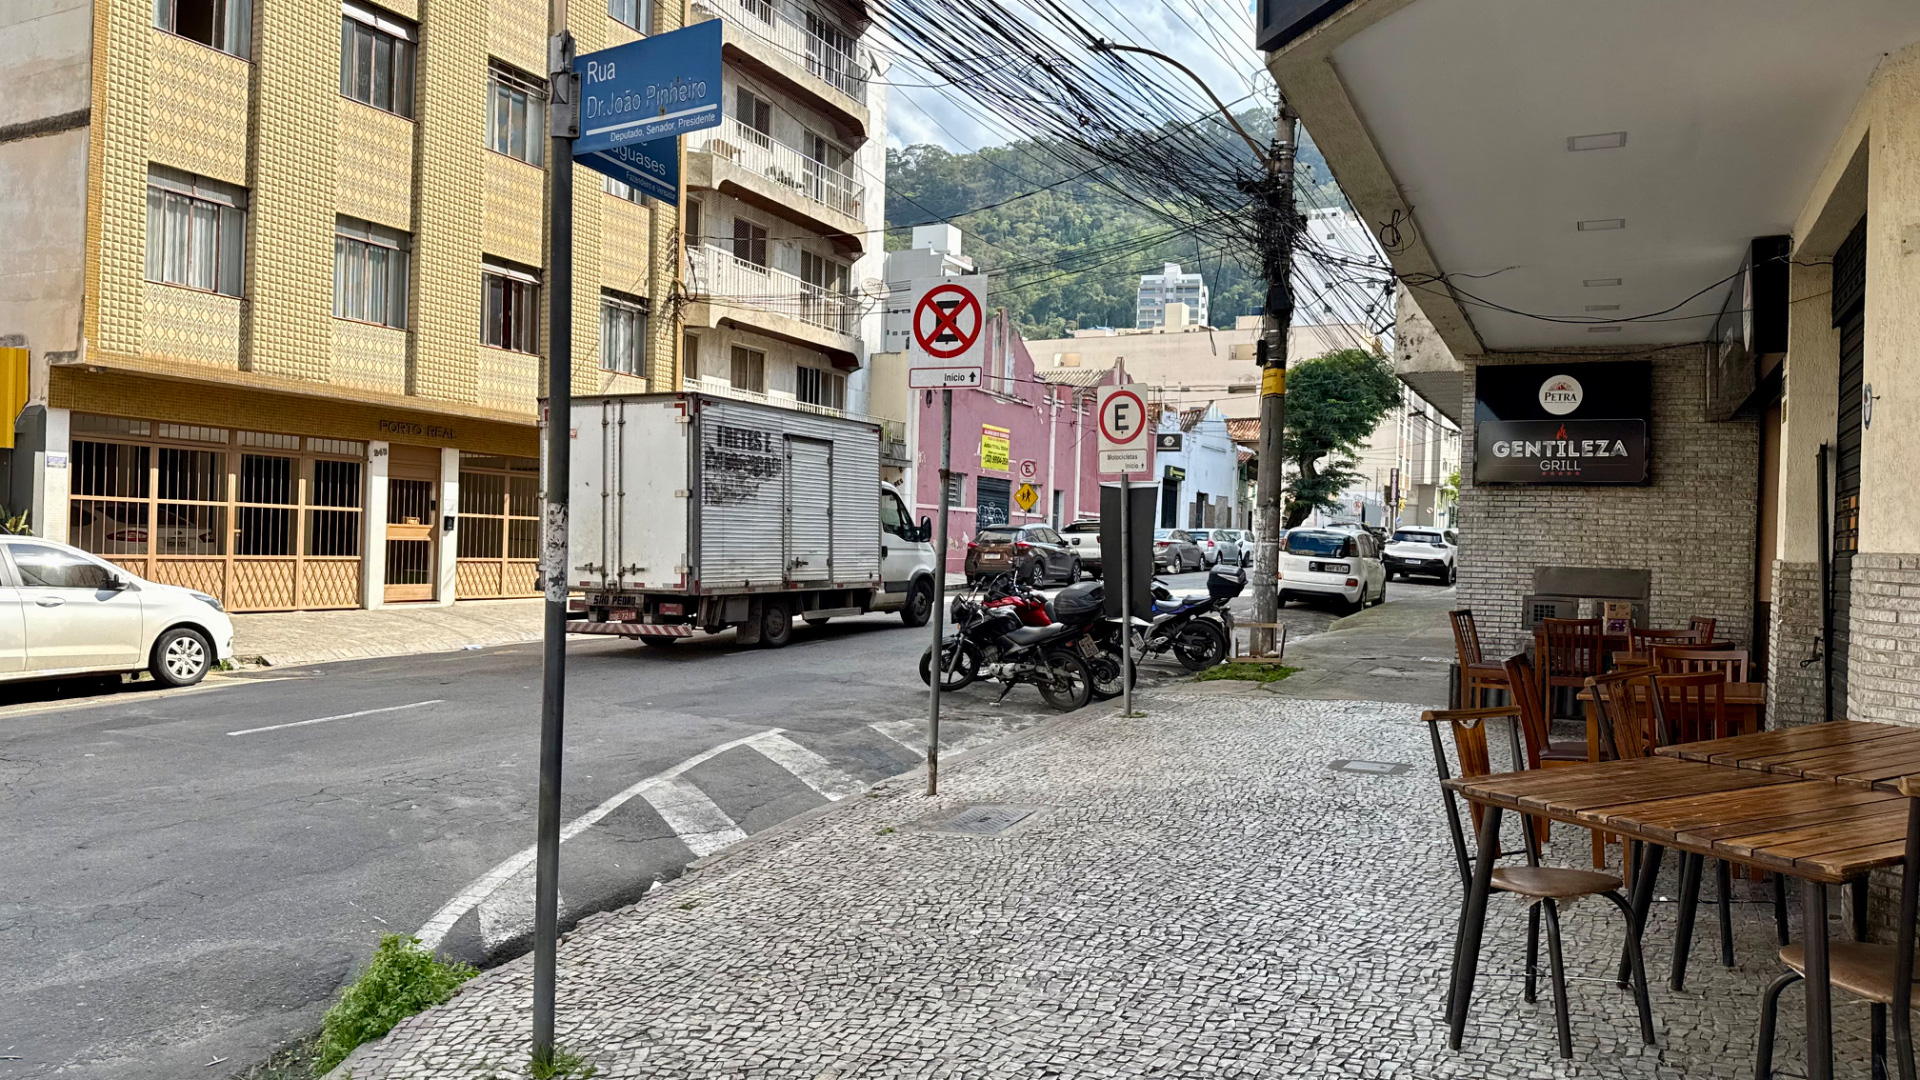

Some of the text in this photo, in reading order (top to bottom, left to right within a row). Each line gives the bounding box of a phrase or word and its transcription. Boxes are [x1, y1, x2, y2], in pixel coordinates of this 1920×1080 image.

[586, 61, 615, 84] Rua
[586, 89, 641, 119] Dr.João
[646, 77, 707, 108] Pinheiro
[610, 113, 716, 142] Deputado, Senador, Presidente
[1544, 391, 1577, 402] PETRA
[1114, 404, 1129, 431] E
[379, 420, 456, 439] PORTO REAL
[1492, 439, 1628, 458] GENTILEZA
[1540, 460, 1582, 471] GRILL
